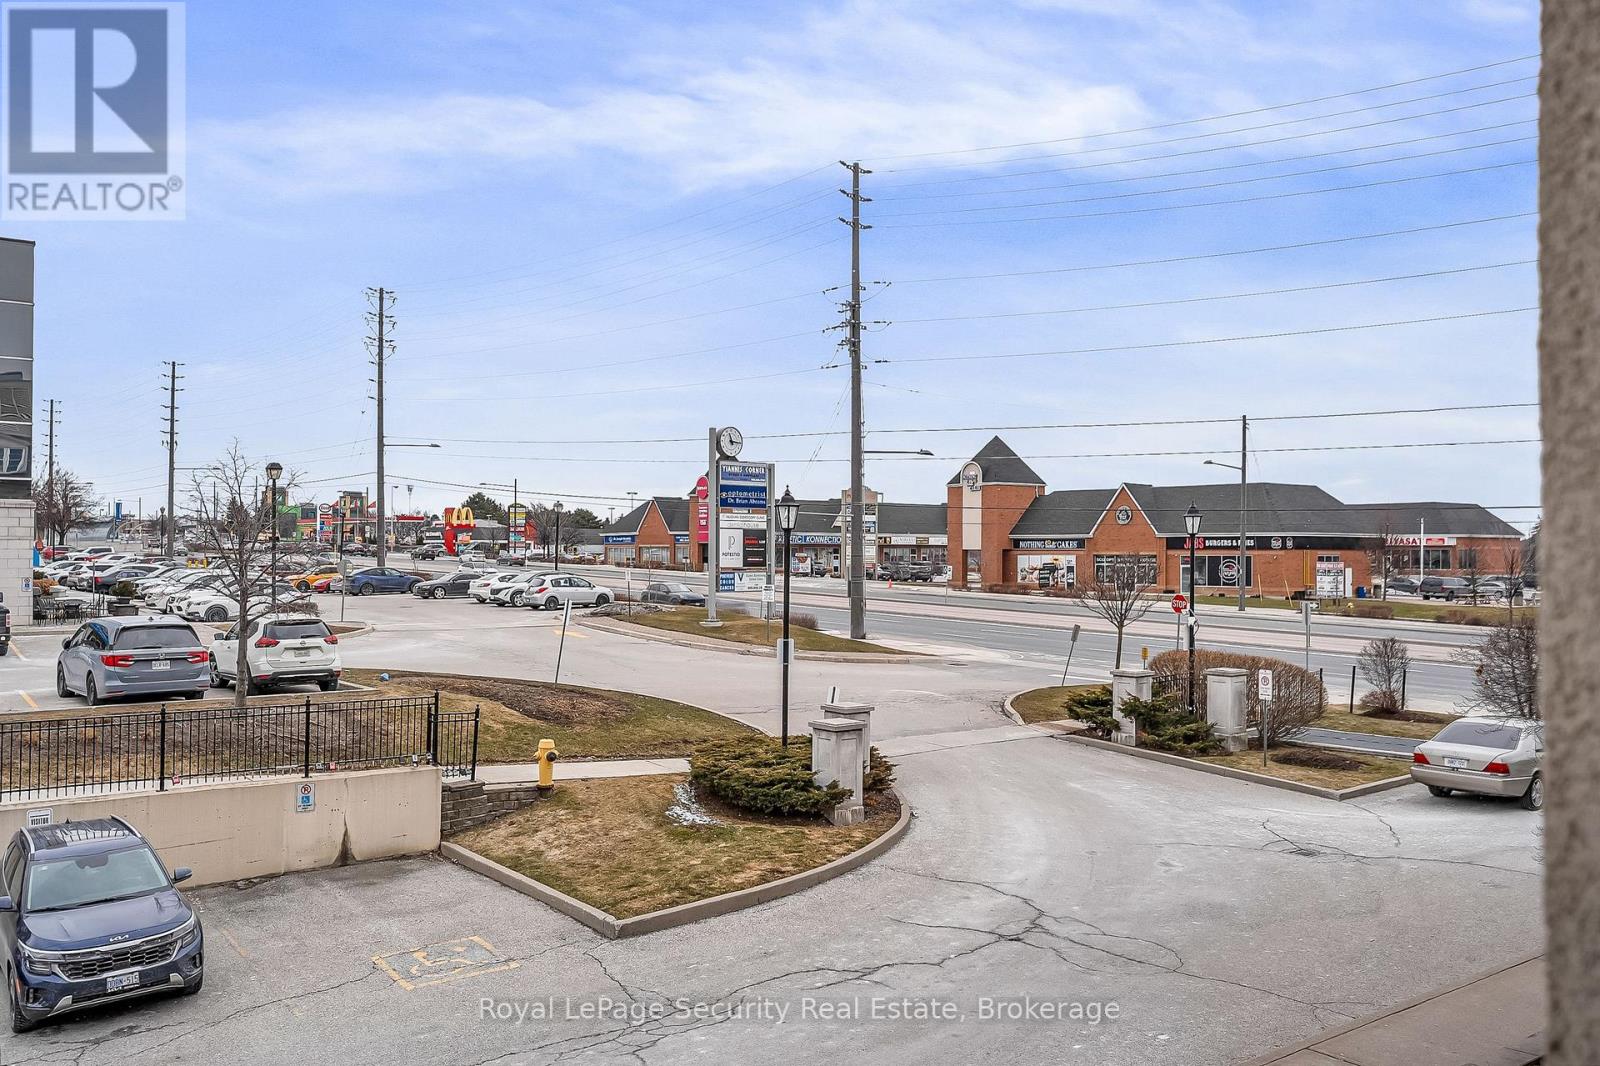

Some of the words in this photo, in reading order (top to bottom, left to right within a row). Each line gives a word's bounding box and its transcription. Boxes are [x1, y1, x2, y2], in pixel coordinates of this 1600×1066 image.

[744, 466, 766, 474] CORNER
[728, 490, 766, 499] optometrist
[806, 535, 842, 545] KONNECTIO
[1020, 540, 1045, 549] NOTHING
[1056, 540, 1078, 549] CAKES
[1183, 537, 1205, 549] JBS
[1205, 539, 1232, 547] BURGERS
[1172, 599, 1187, 609] STOP
